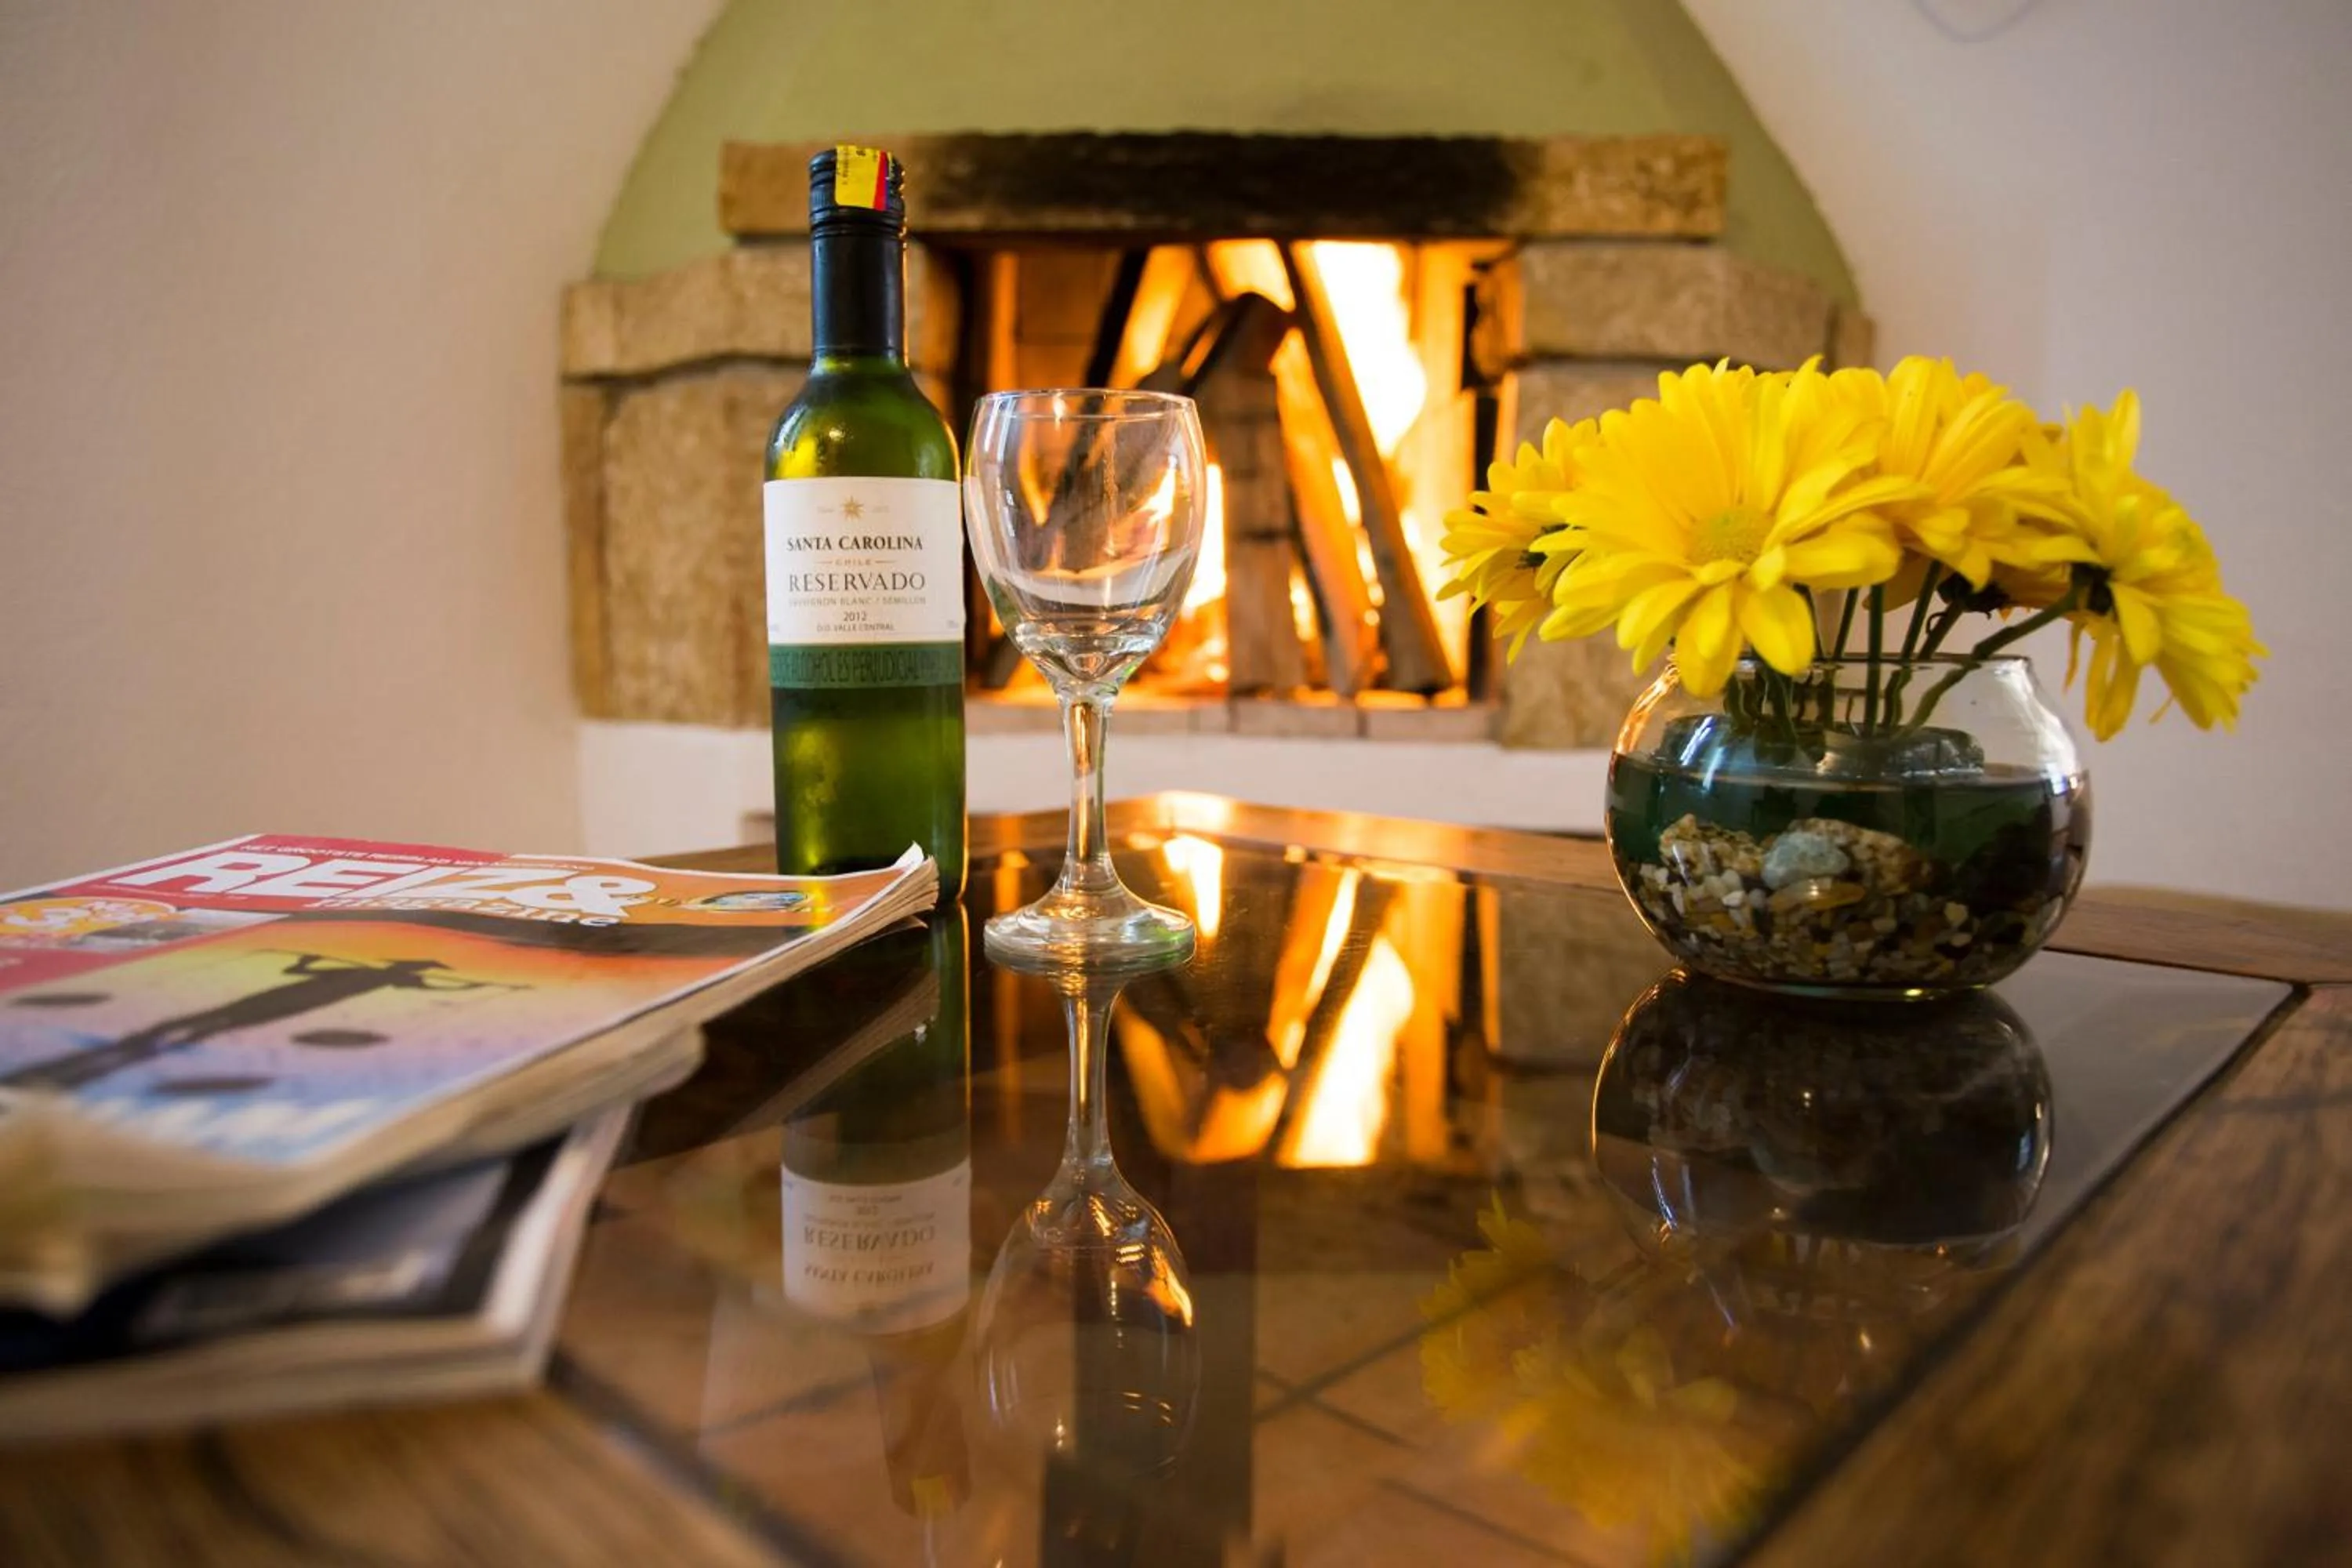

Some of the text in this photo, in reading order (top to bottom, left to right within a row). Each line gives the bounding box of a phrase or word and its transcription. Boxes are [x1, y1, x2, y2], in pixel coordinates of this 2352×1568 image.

[786, 535, 924, 551] SANTA CAROLINA
[834, 557, 873, 566] CHILE
[789, 572, 926, 593] RESERVADO
[843, 611, 867, 622] 2012
